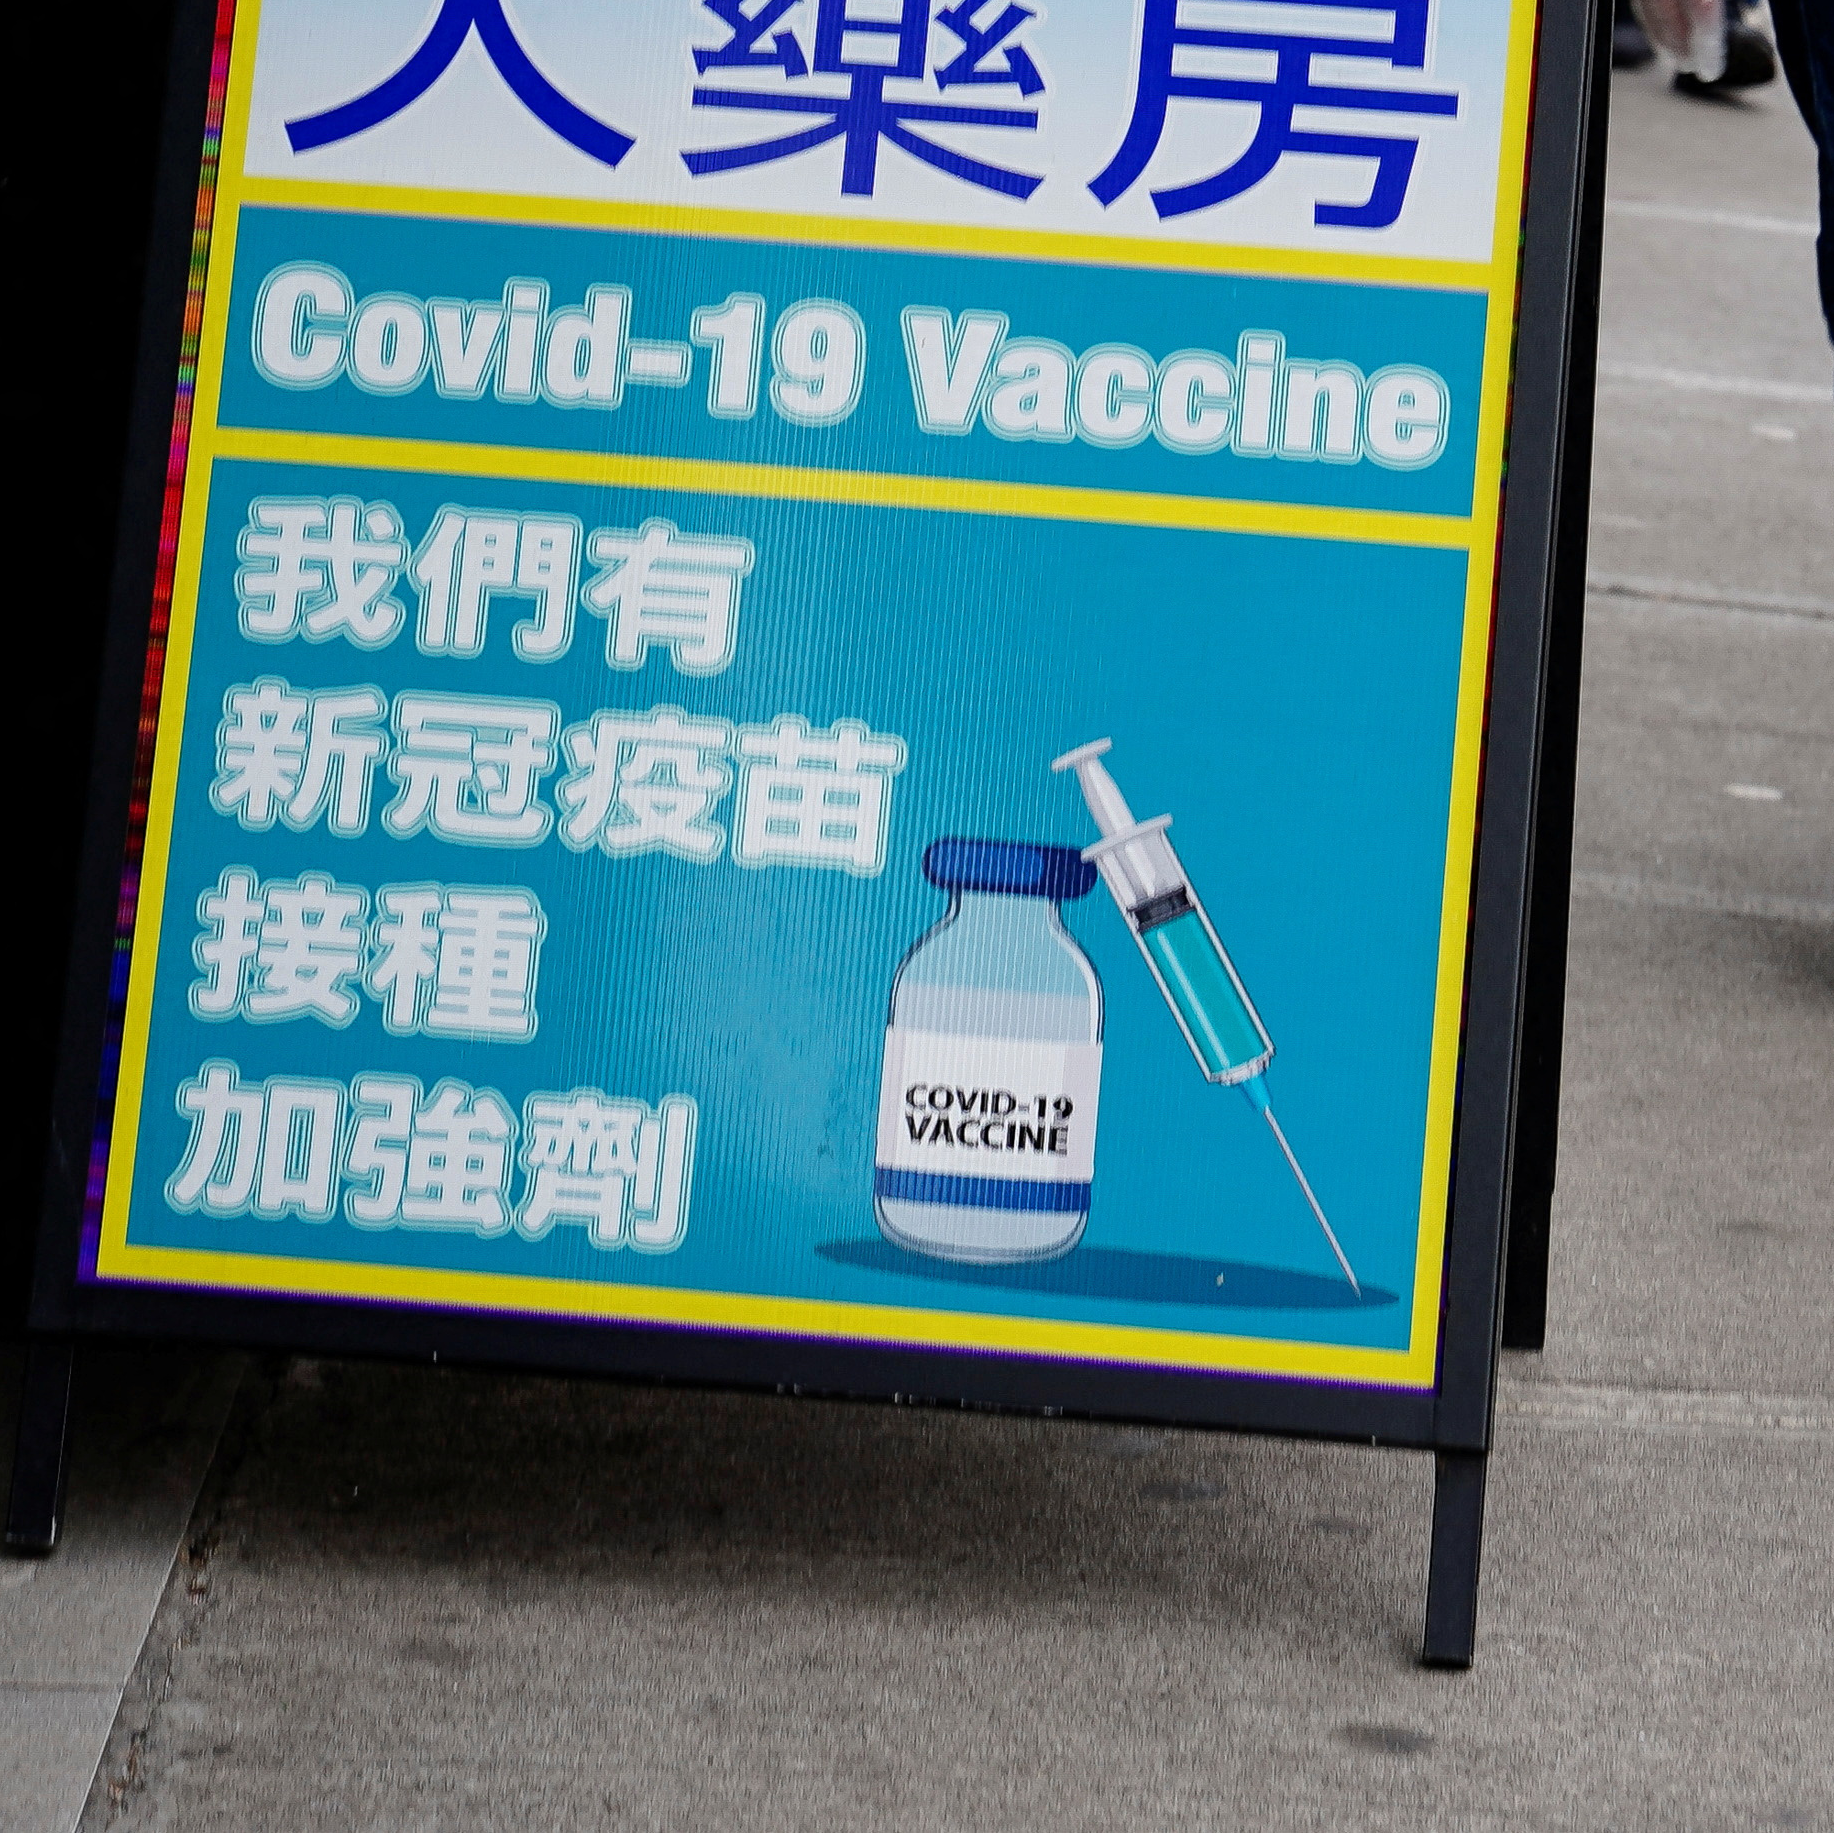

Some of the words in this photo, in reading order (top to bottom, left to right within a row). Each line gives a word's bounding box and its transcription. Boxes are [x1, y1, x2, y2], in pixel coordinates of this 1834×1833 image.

[254, 263, 869, 428] Covid-19
[903, 308, 1451, 470] Vaccine
[233, 494, 755, 676] 我們有
[210, 675, 907, 878] 新冠疫苗
[189, 870, 548, 1042] 接種
[166, 1063, 697, 1256] 加強劑
[905, 1082, 1074, 1119] COVID-19
[905, 1113, 1069, 1157] VACCINE
